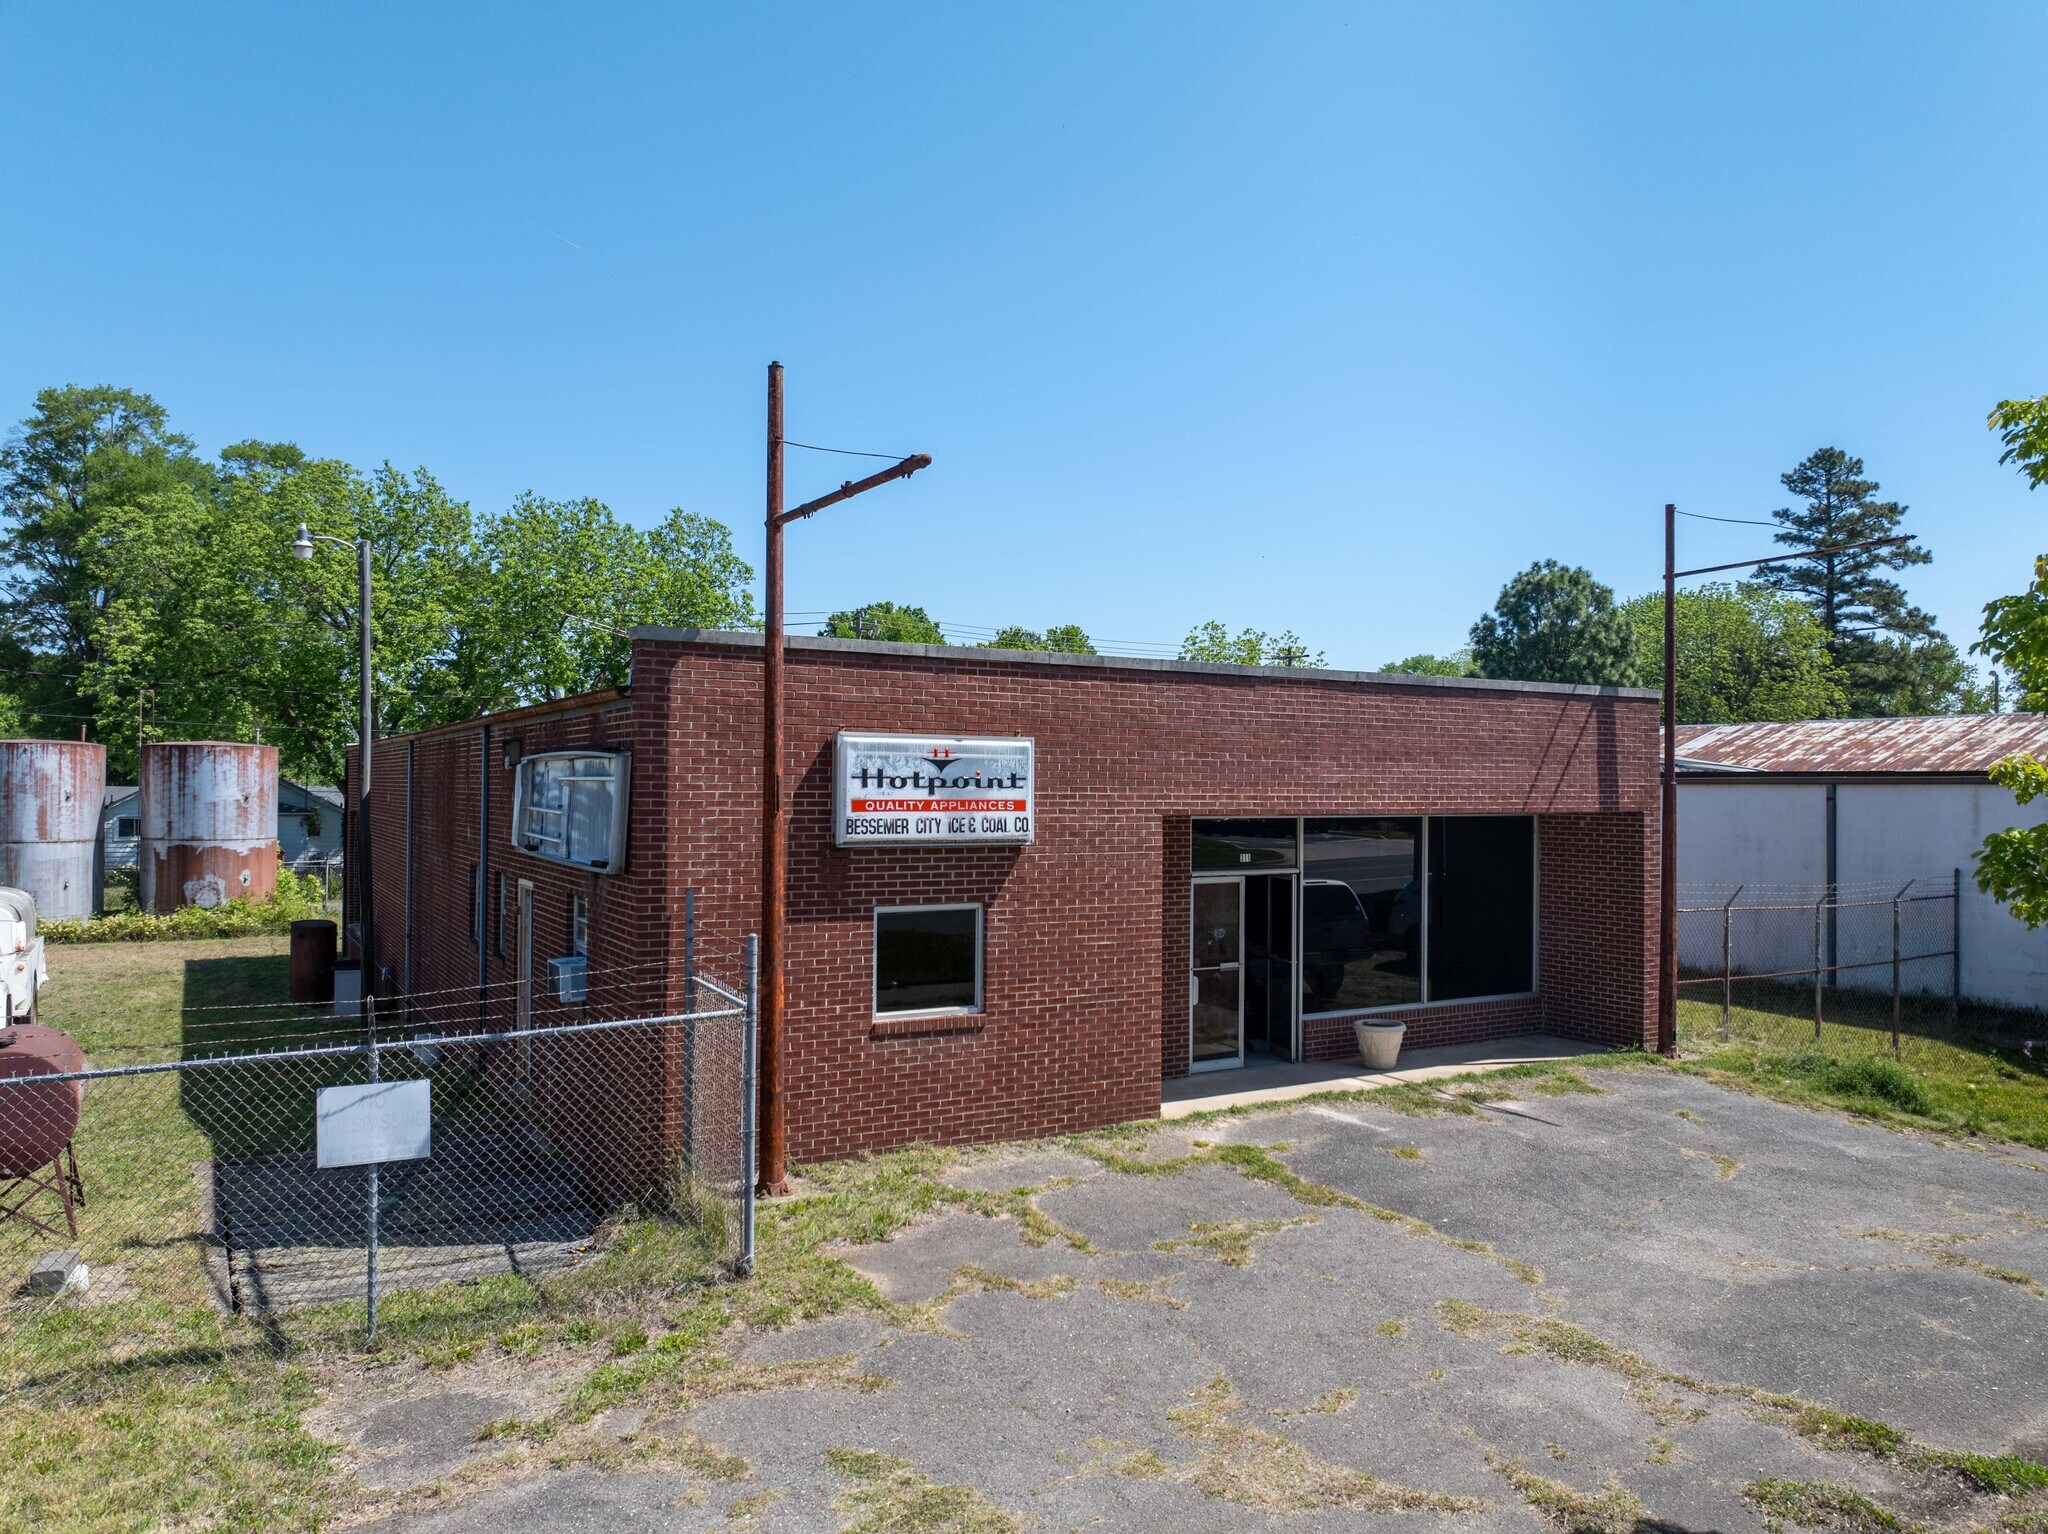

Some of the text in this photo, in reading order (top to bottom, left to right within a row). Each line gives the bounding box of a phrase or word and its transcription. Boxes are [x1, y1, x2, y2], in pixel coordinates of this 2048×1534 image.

[852, 767, 1026, 795] Hotpoint
[865, 801, 1015, 811] QUALITY APPLIANCES
[846, 818, 909, 835] BESSEMER
[916, 818, 941, 834] CITY
[948, 817, 966, 833] ICE
[968, 817, 976, 833] &
[982, 817, 1011, 833] COAL
[361, 1093, 387, 1110] NO
[324, 1110, 425, 1137] TRESPASSING
